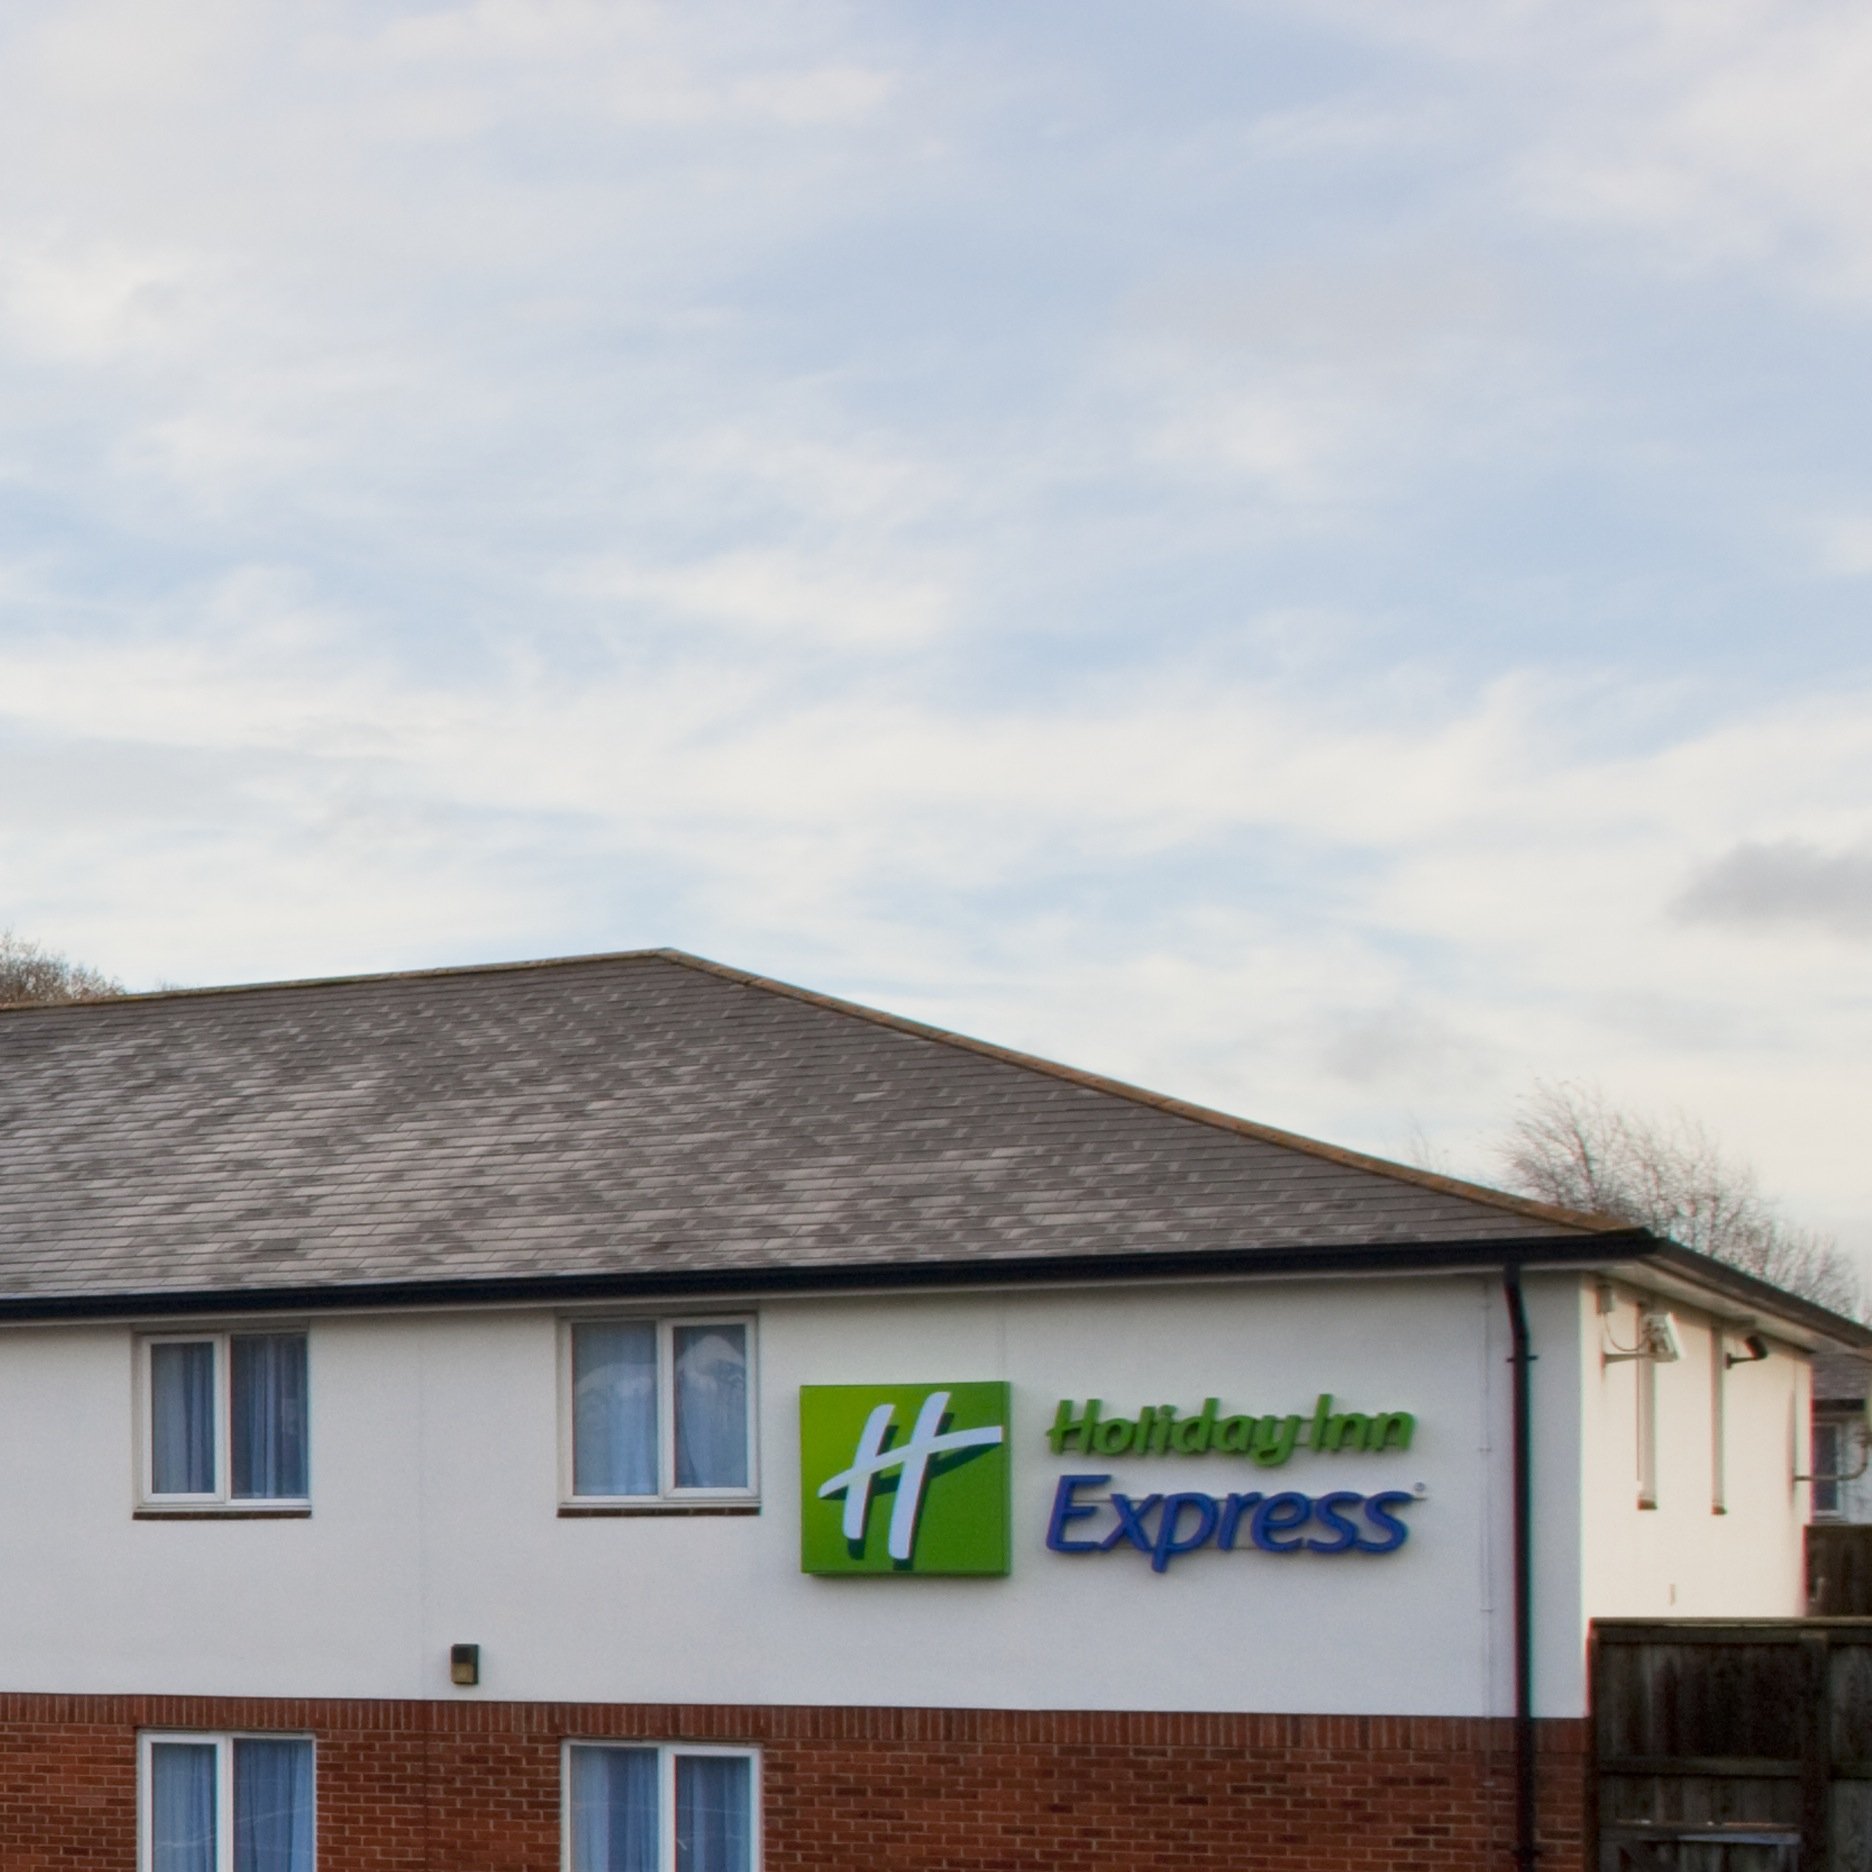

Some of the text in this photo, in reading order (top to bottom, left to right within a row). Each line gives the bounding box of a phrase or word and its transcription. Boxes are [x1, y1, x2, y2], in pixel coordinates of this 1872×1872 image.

[1046, 1393, 1417, 1467] Holiday Inn
[1045, 1474, 1414, 1573] Express
